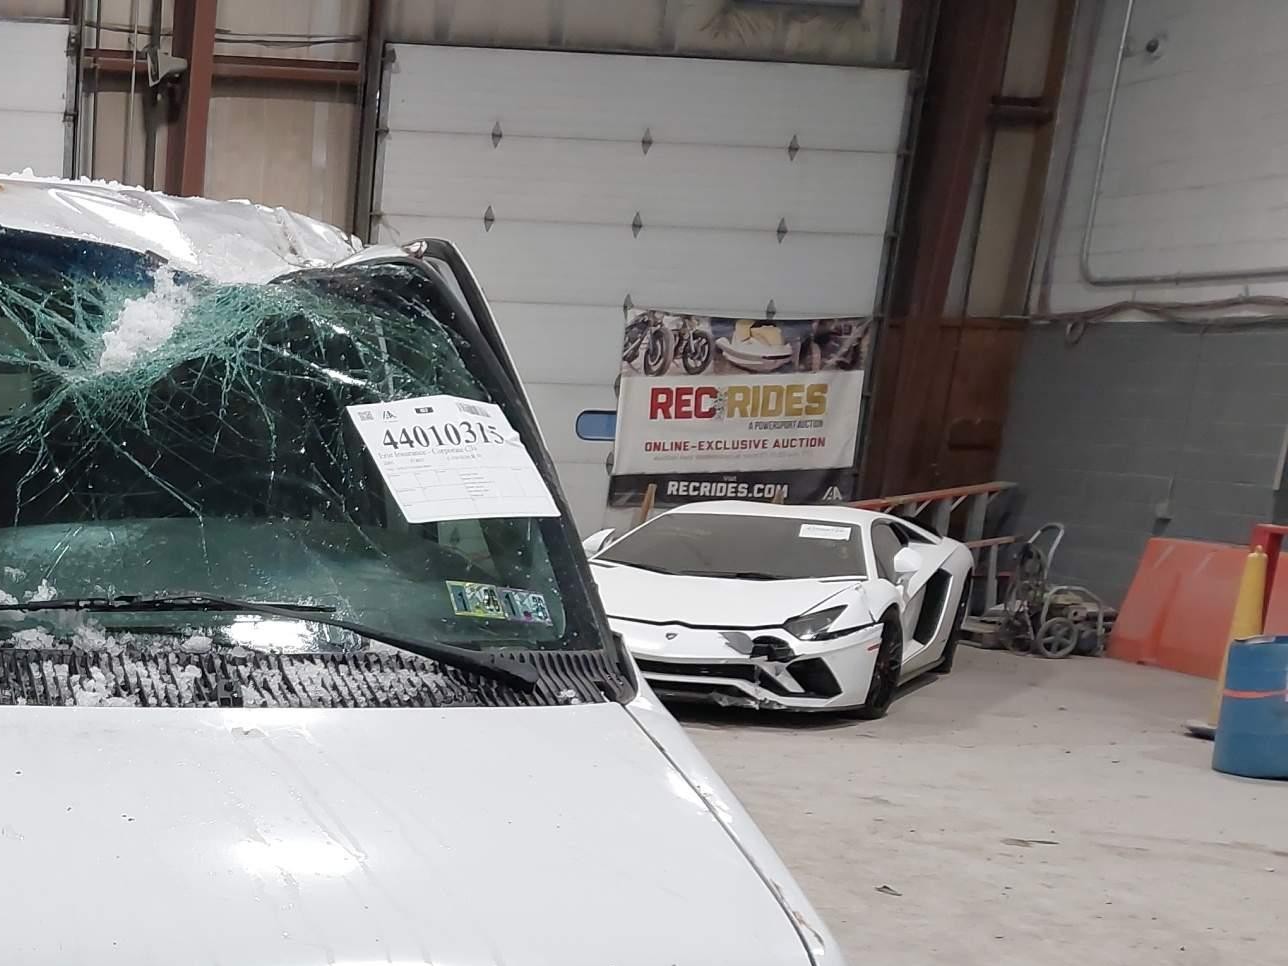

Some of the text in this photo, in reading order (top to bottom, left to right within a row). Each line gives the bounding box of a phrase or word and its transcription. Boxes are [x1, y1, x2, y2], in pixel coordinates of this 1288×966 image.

[649, 383, 828, 420] REC RIDES
[755, 420, 797, 430] POWERSPORT
[797, 420, 824, 429] AUCTION
[383, 421, 504, 449] 44010315
[644, 437, 826, 452] ONLINE-EXCLUSIVE AUCTION
[667, 480, 789, 499] RECRIDES.COM
